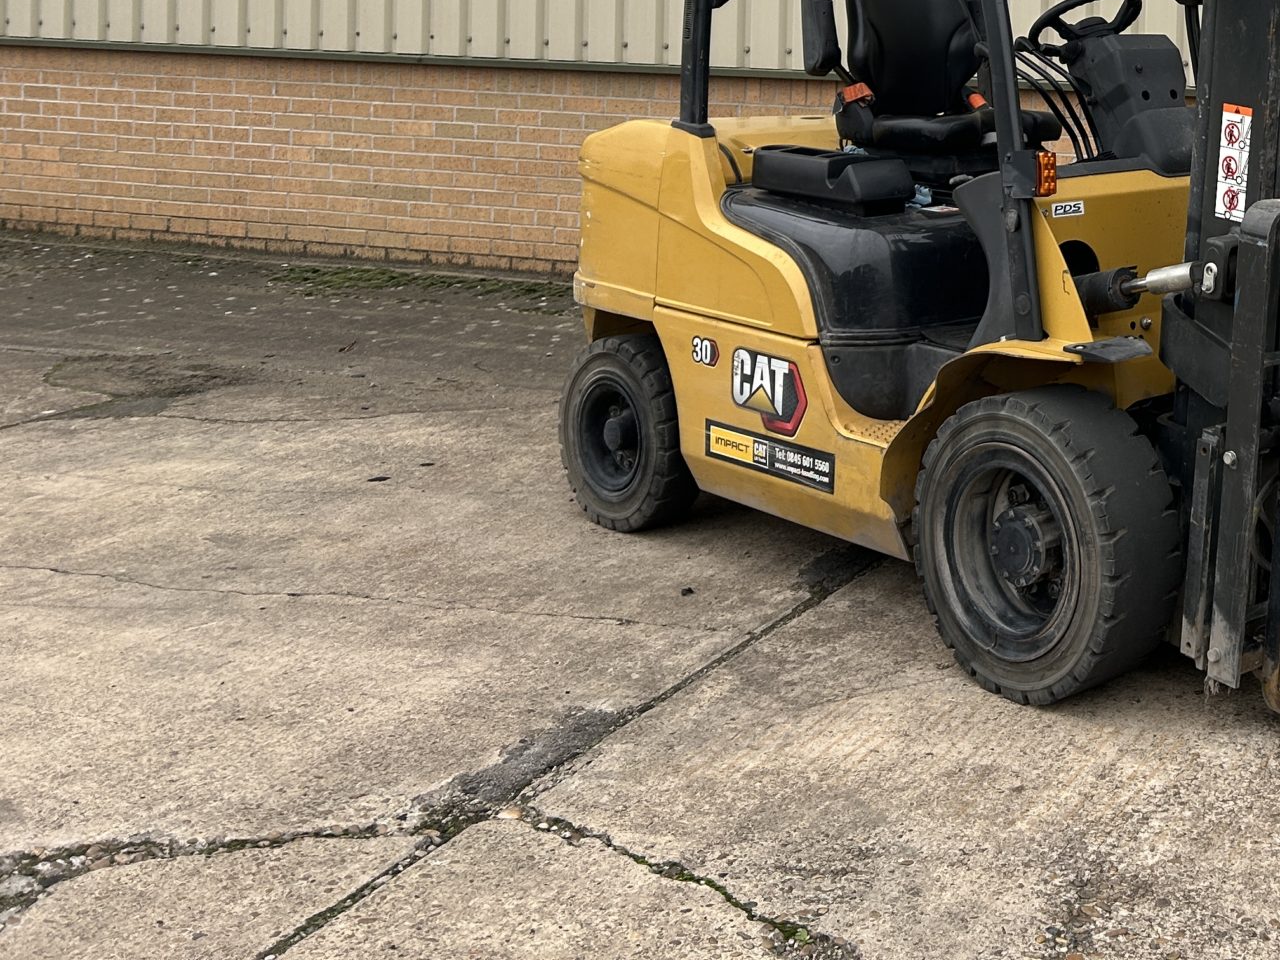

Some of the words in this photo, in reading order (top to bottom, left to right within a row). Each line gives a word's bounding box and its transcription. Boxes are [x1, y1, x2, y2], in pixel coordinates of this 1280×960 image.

[1053, 202, 1082, 215] PDS
[692, 337, 711, 365] 30
[733, 348, 790, 416] CAT
[754, 442, 767, 457] CAT
